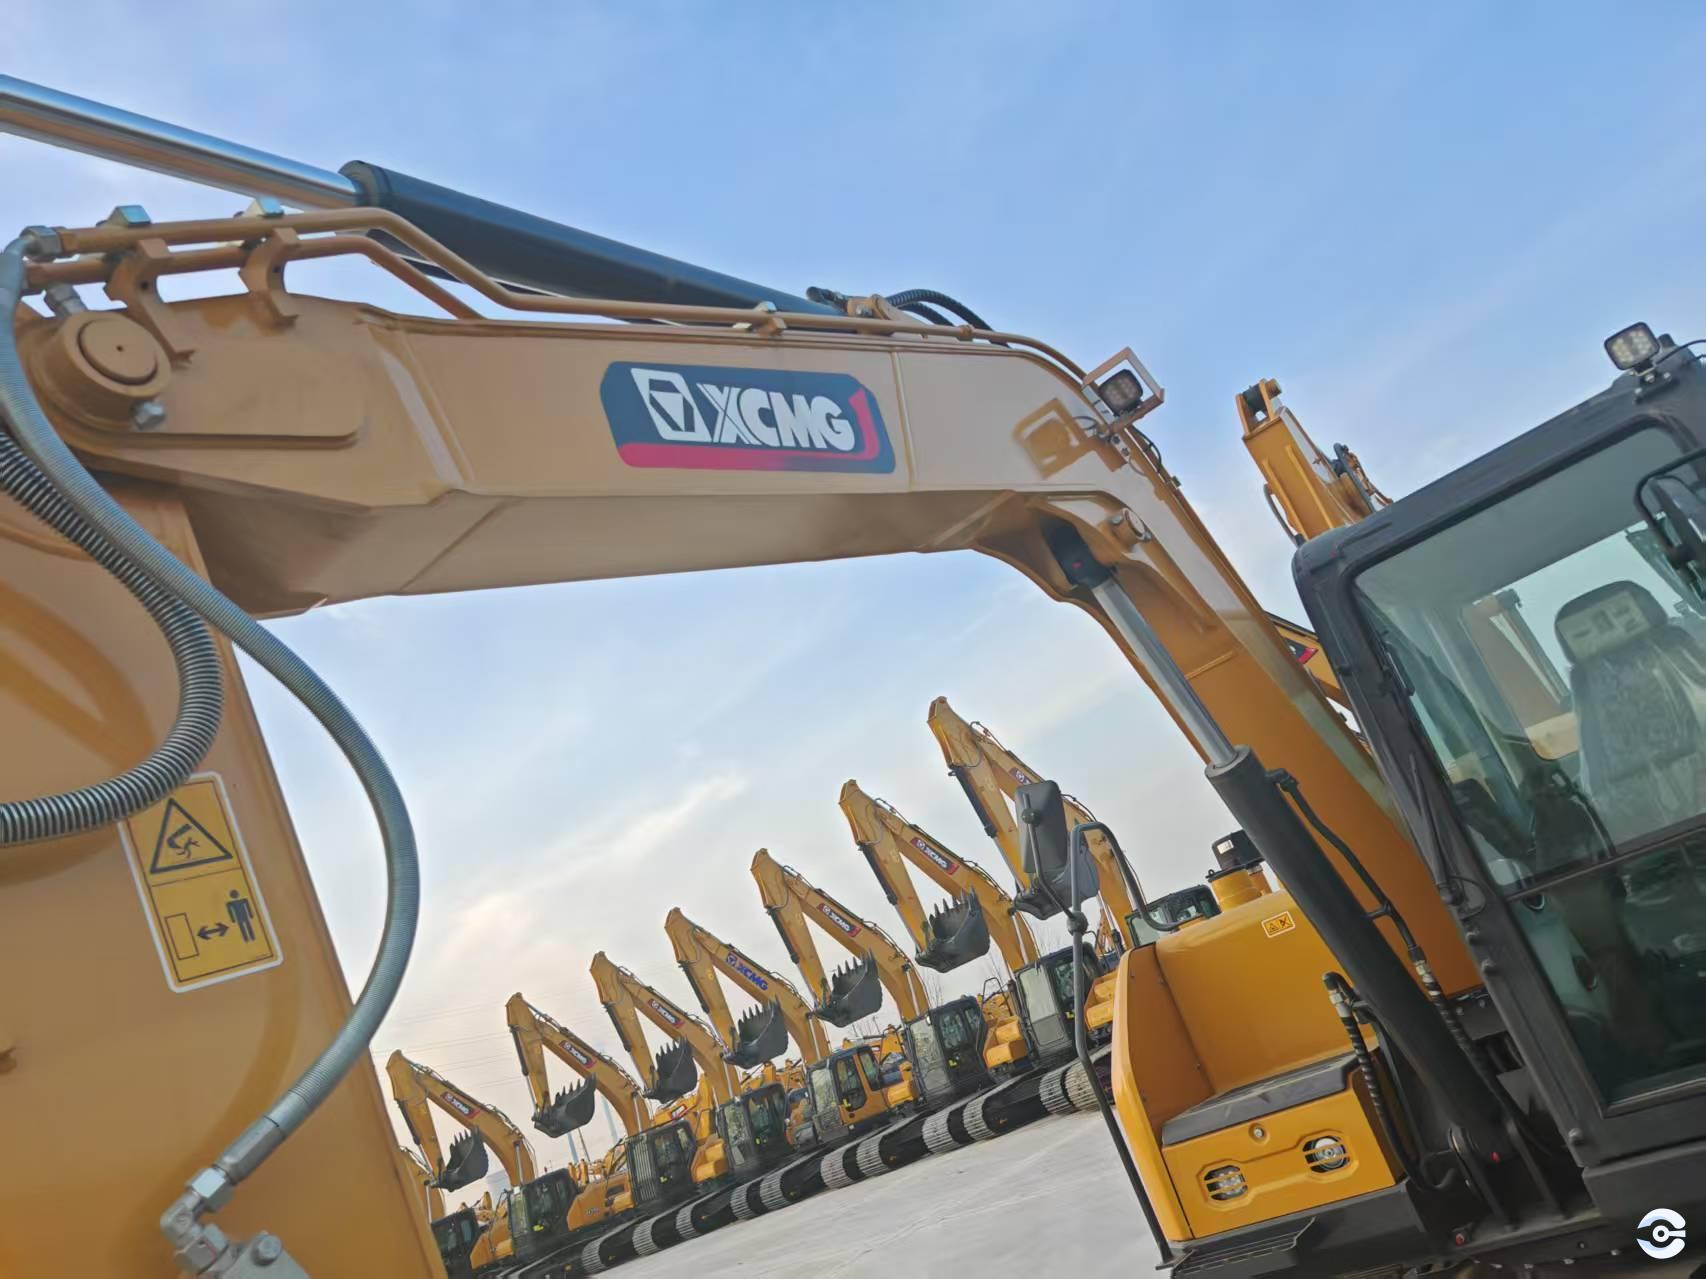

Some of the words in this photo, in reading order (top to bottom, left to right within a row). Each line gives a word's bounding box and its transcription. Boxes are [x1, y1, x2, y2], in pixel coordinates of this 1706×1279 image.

[696, 383, 855, 451] XCMG
[924, 847, 948, 869] XCMG
[830, 911, 851, 932] XCMG
[736, 964, 768, 991] XCMG
